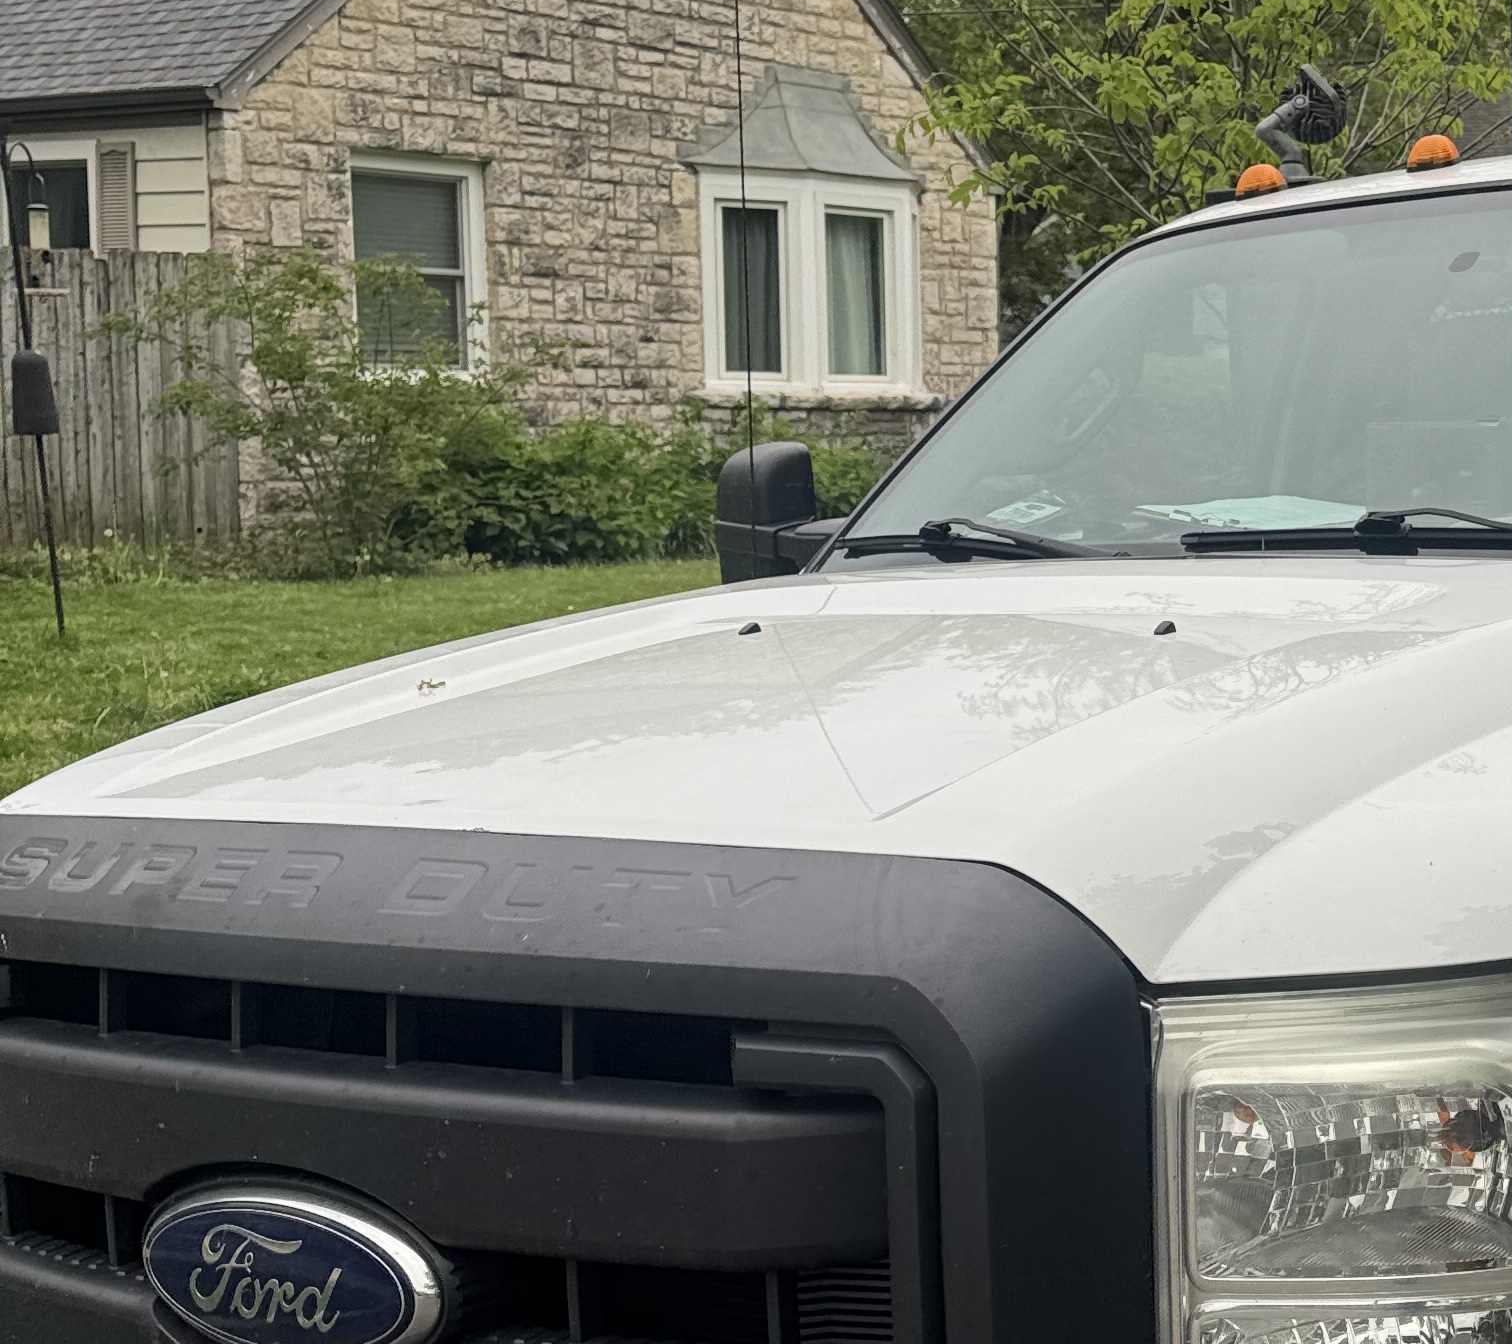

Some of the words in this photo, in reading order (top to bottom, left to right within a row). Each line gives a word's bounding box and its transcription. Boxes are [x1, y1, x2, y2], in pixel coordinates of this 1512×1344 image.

[0, 836, 344, 908] SUPER
[376, 857, 799, 932] DUTY
[189, 1223, 342, 1333] Ford
